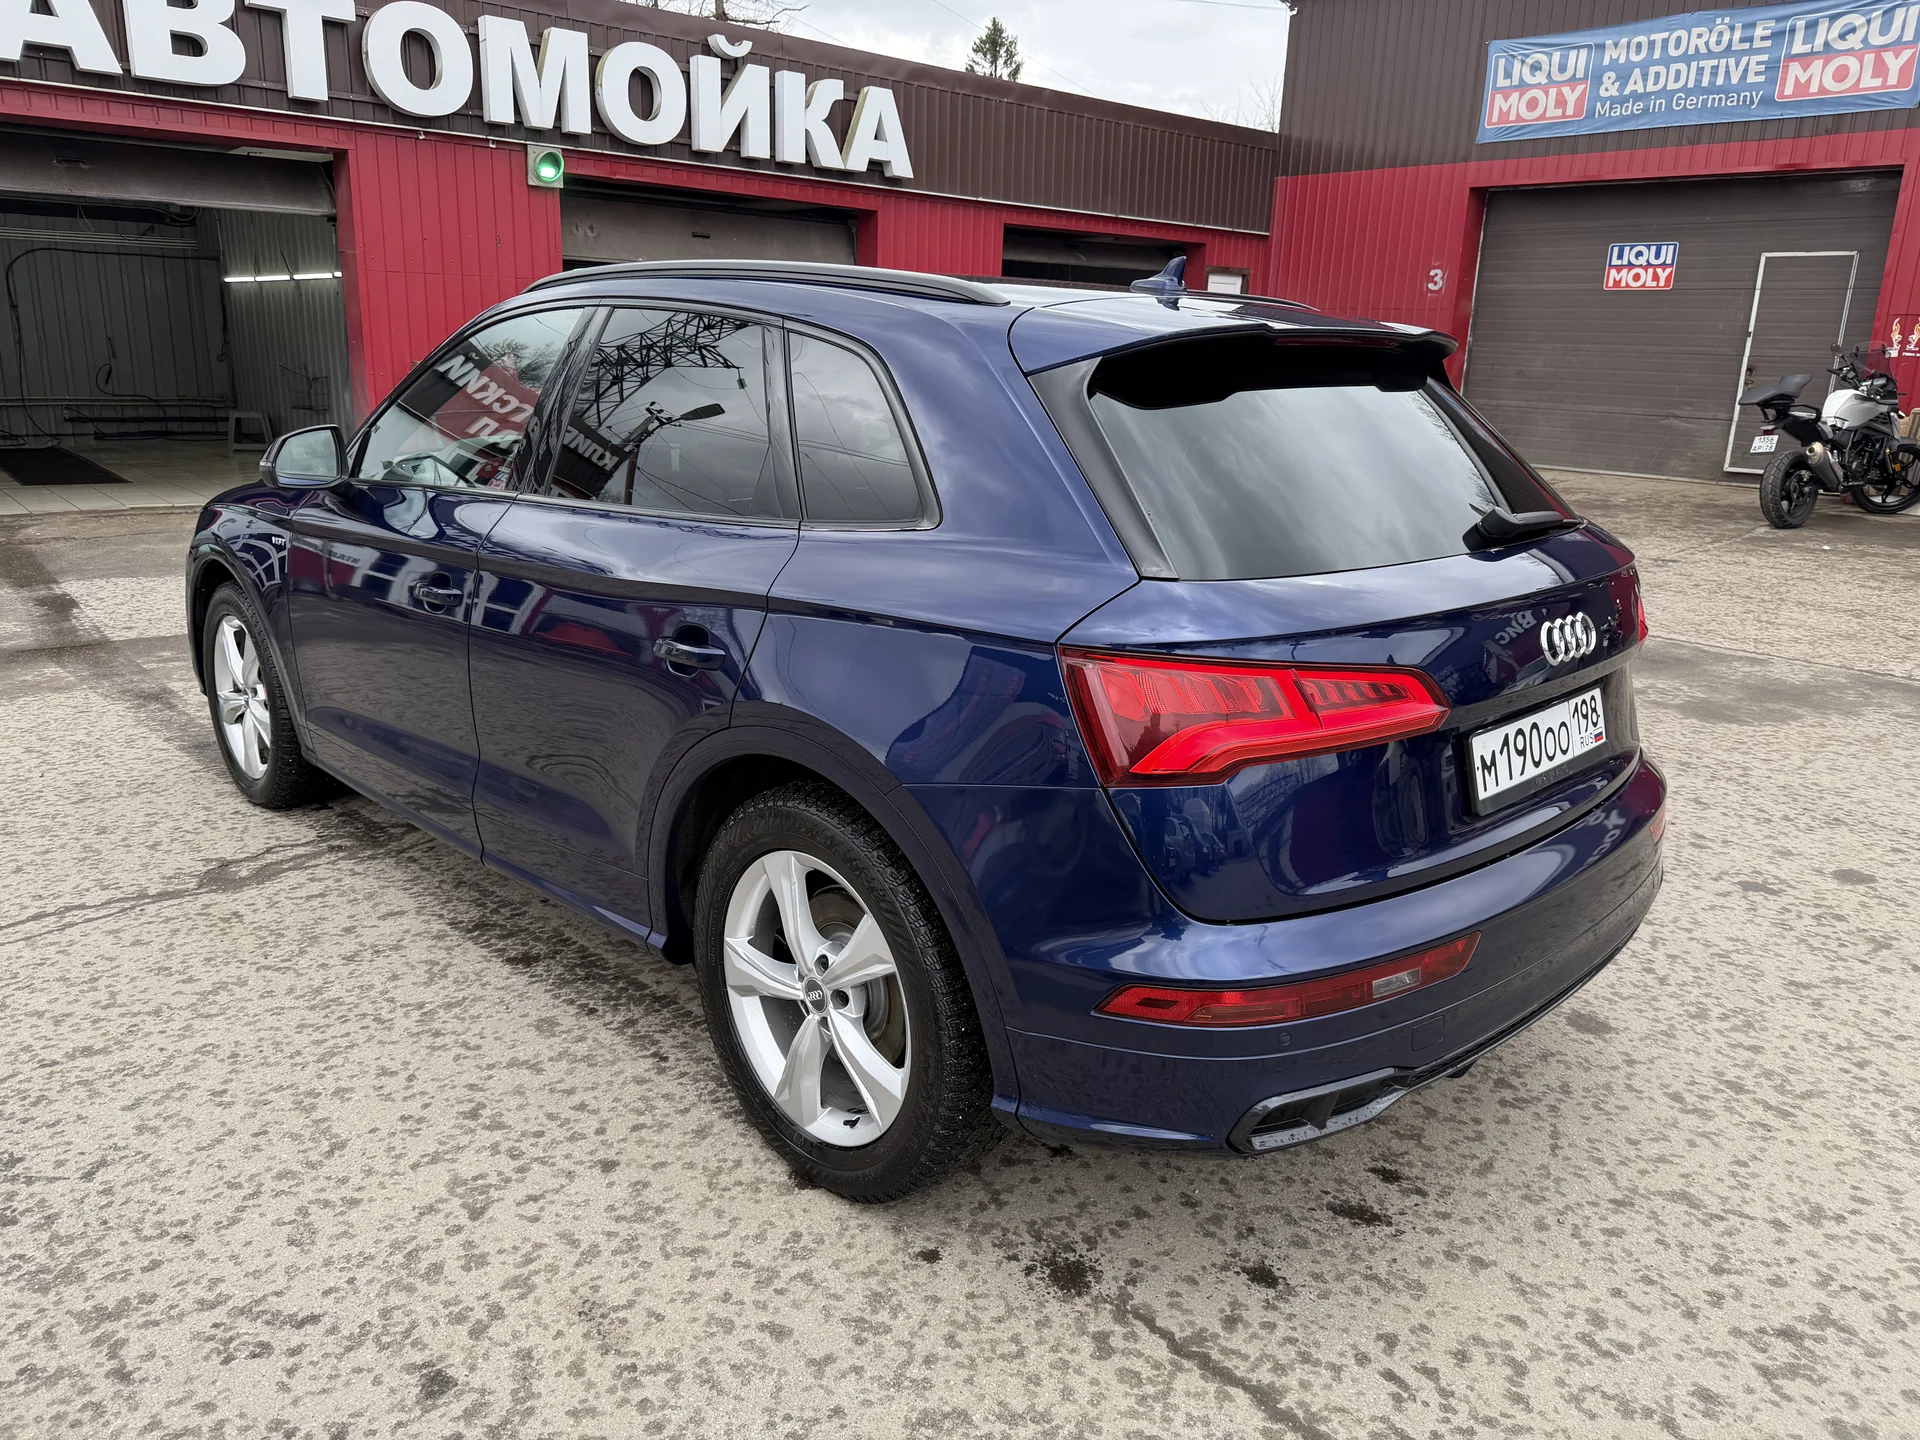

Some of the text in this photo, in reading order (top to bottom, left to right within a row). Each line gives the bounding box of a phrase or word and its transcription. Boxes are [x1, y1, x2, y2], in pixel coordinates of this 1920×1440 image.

[1603, 17, 1776, 66] MOTORÖLE
[1791, 5, 1920, 54] LIQUI
[1495, 48, 1588, 87] LIQUI
[1599, 54, 1769, 98] & ADDITIVE
[1784, 49, 1916, 95] MOLY
[1491, 83, 1587, 123] MOLY
[1595, 91, 1763, 118] Made in Germany
[1611, 245, 1674, 266] LIQUI
[1428, 269, 1444, 290] 3
[1607, 268, 1673, 287] MOLY
[1572, 694, 1599, 735] 198
[1580, 732, 1594, 749] RUS
